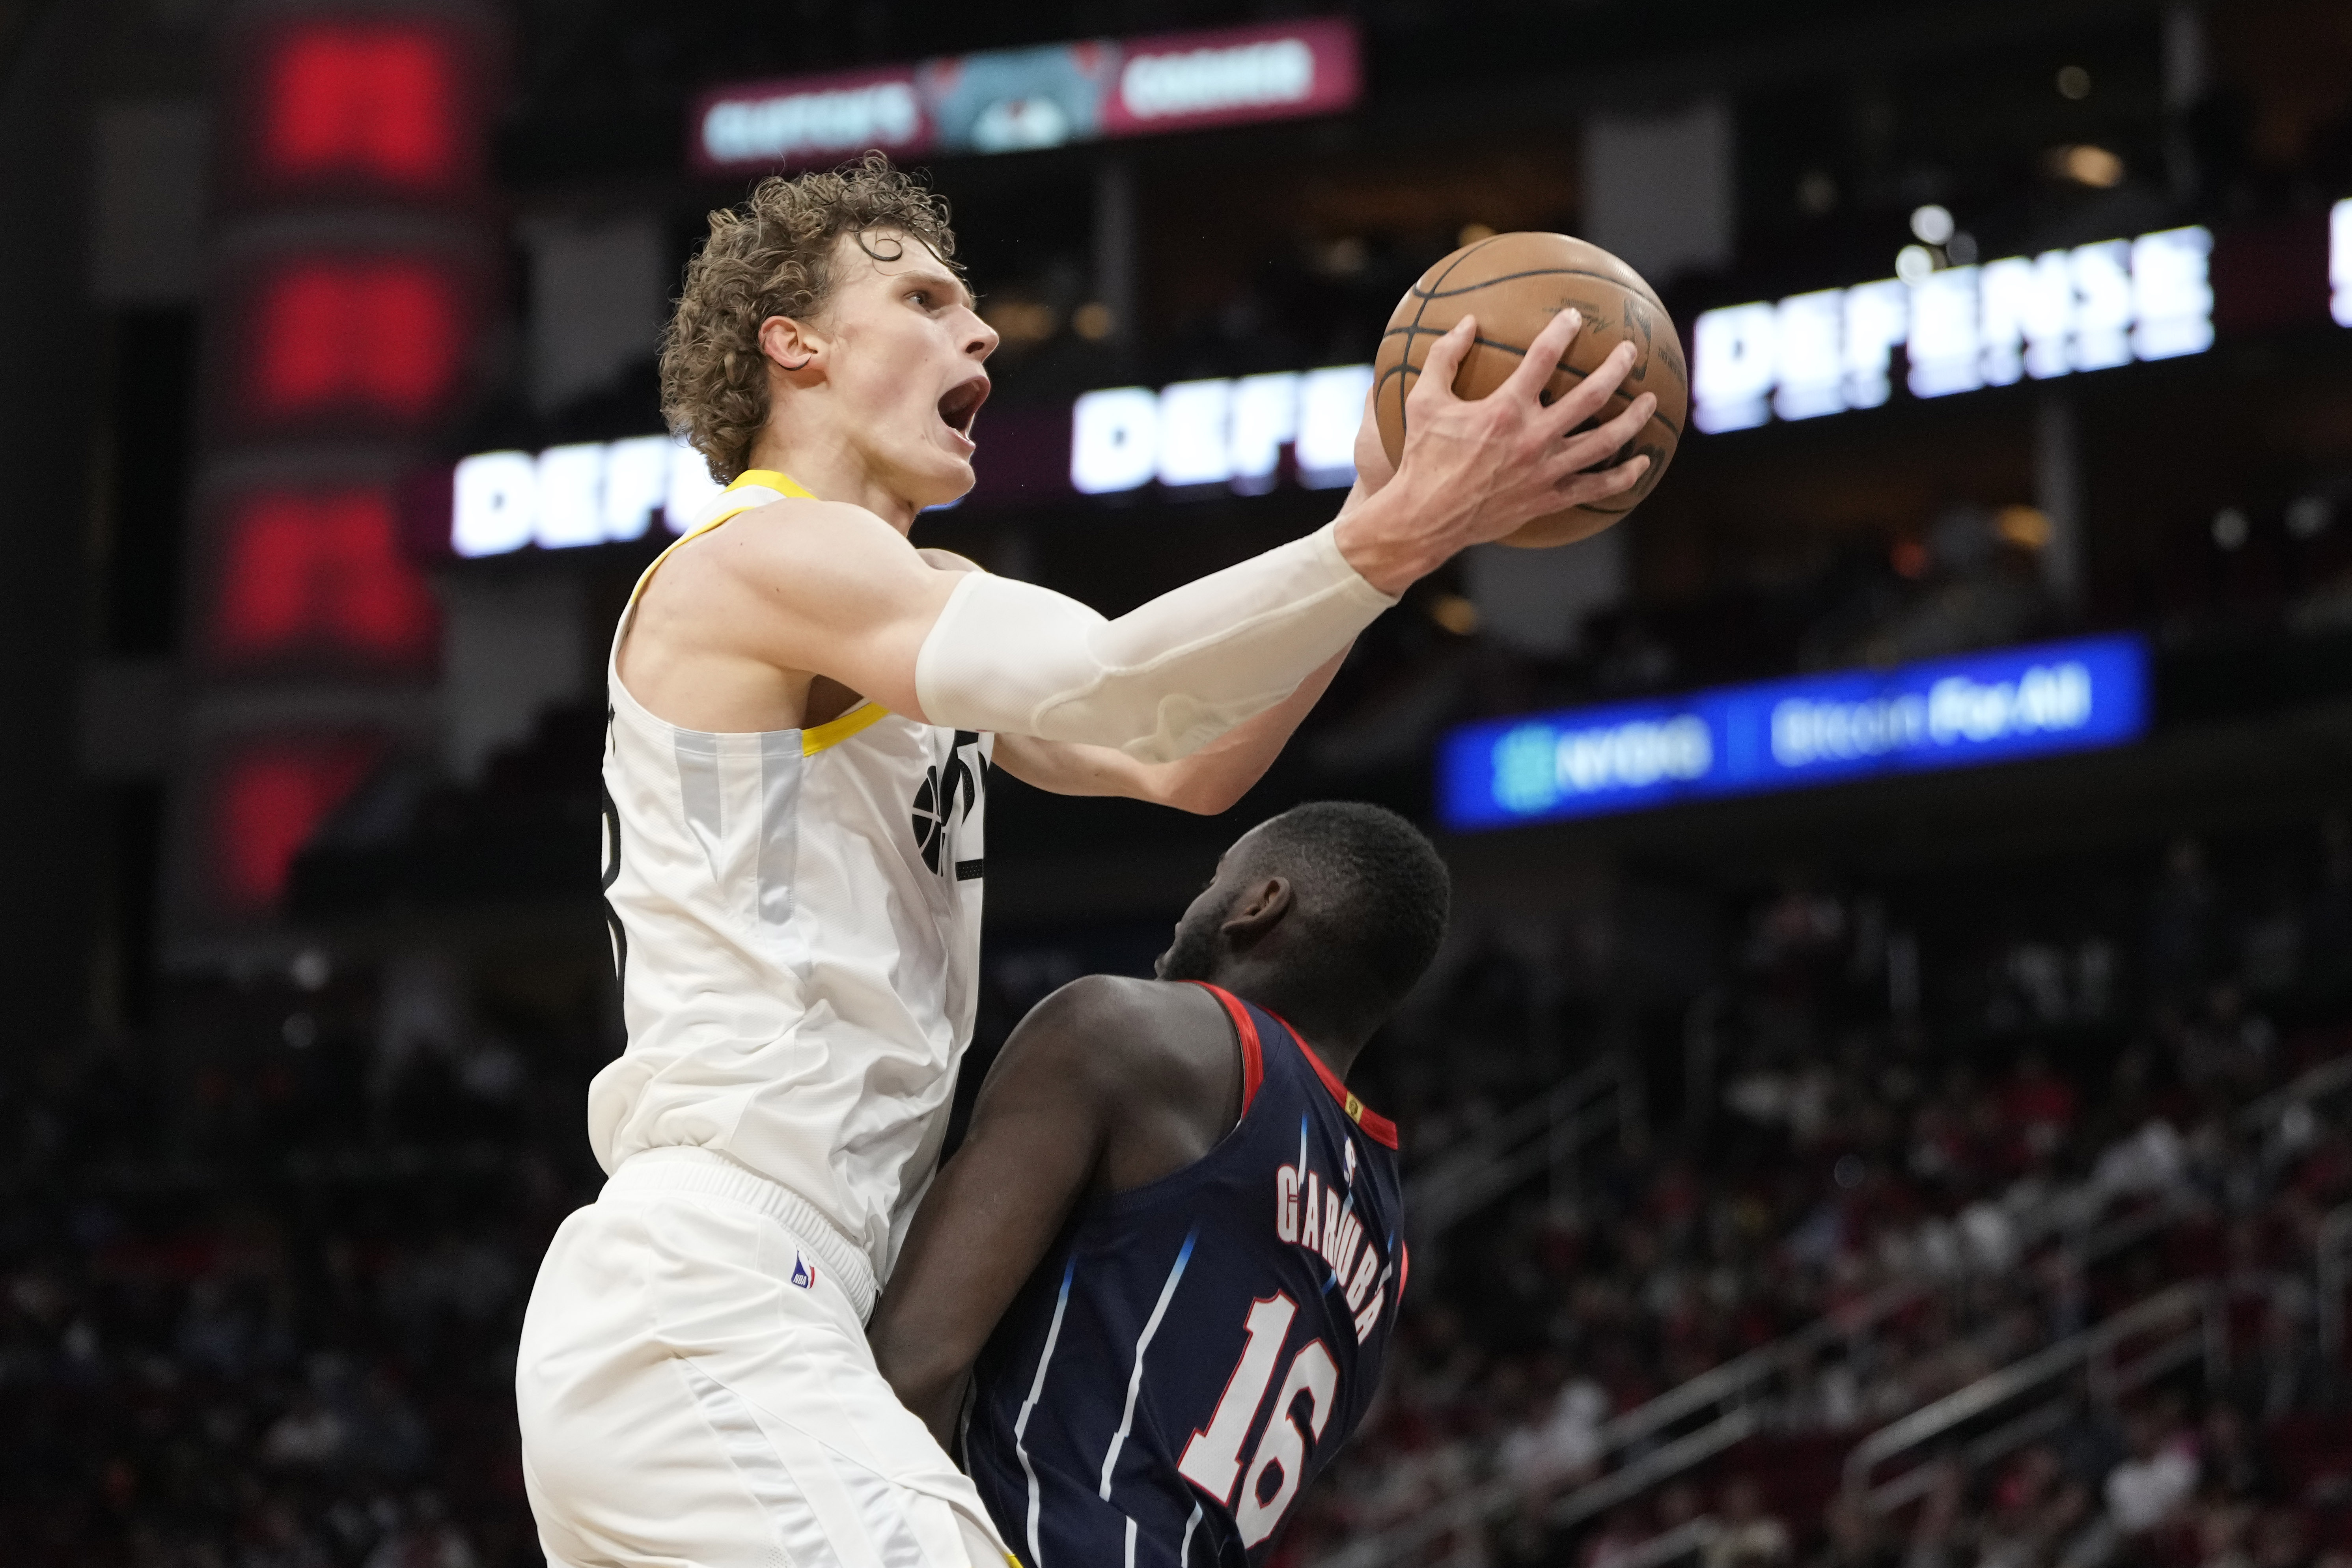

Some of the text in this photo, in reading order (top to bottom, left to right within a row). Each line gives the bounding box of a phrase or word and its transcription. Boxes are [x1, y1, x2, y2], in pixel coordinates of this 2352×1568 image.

[1692, 225, 2215, 434] DEFENSE
[1772, 695, 1925, 766] Bitcoin
[1929, 677, 2013, 746] For
[2013, 662, 2091, 736] All
[793, 1273, 807, 1286] NBA
[1276, 1164, 1384, 1346] GARUBA
[1178, 1289, 1339, 1549] 16
